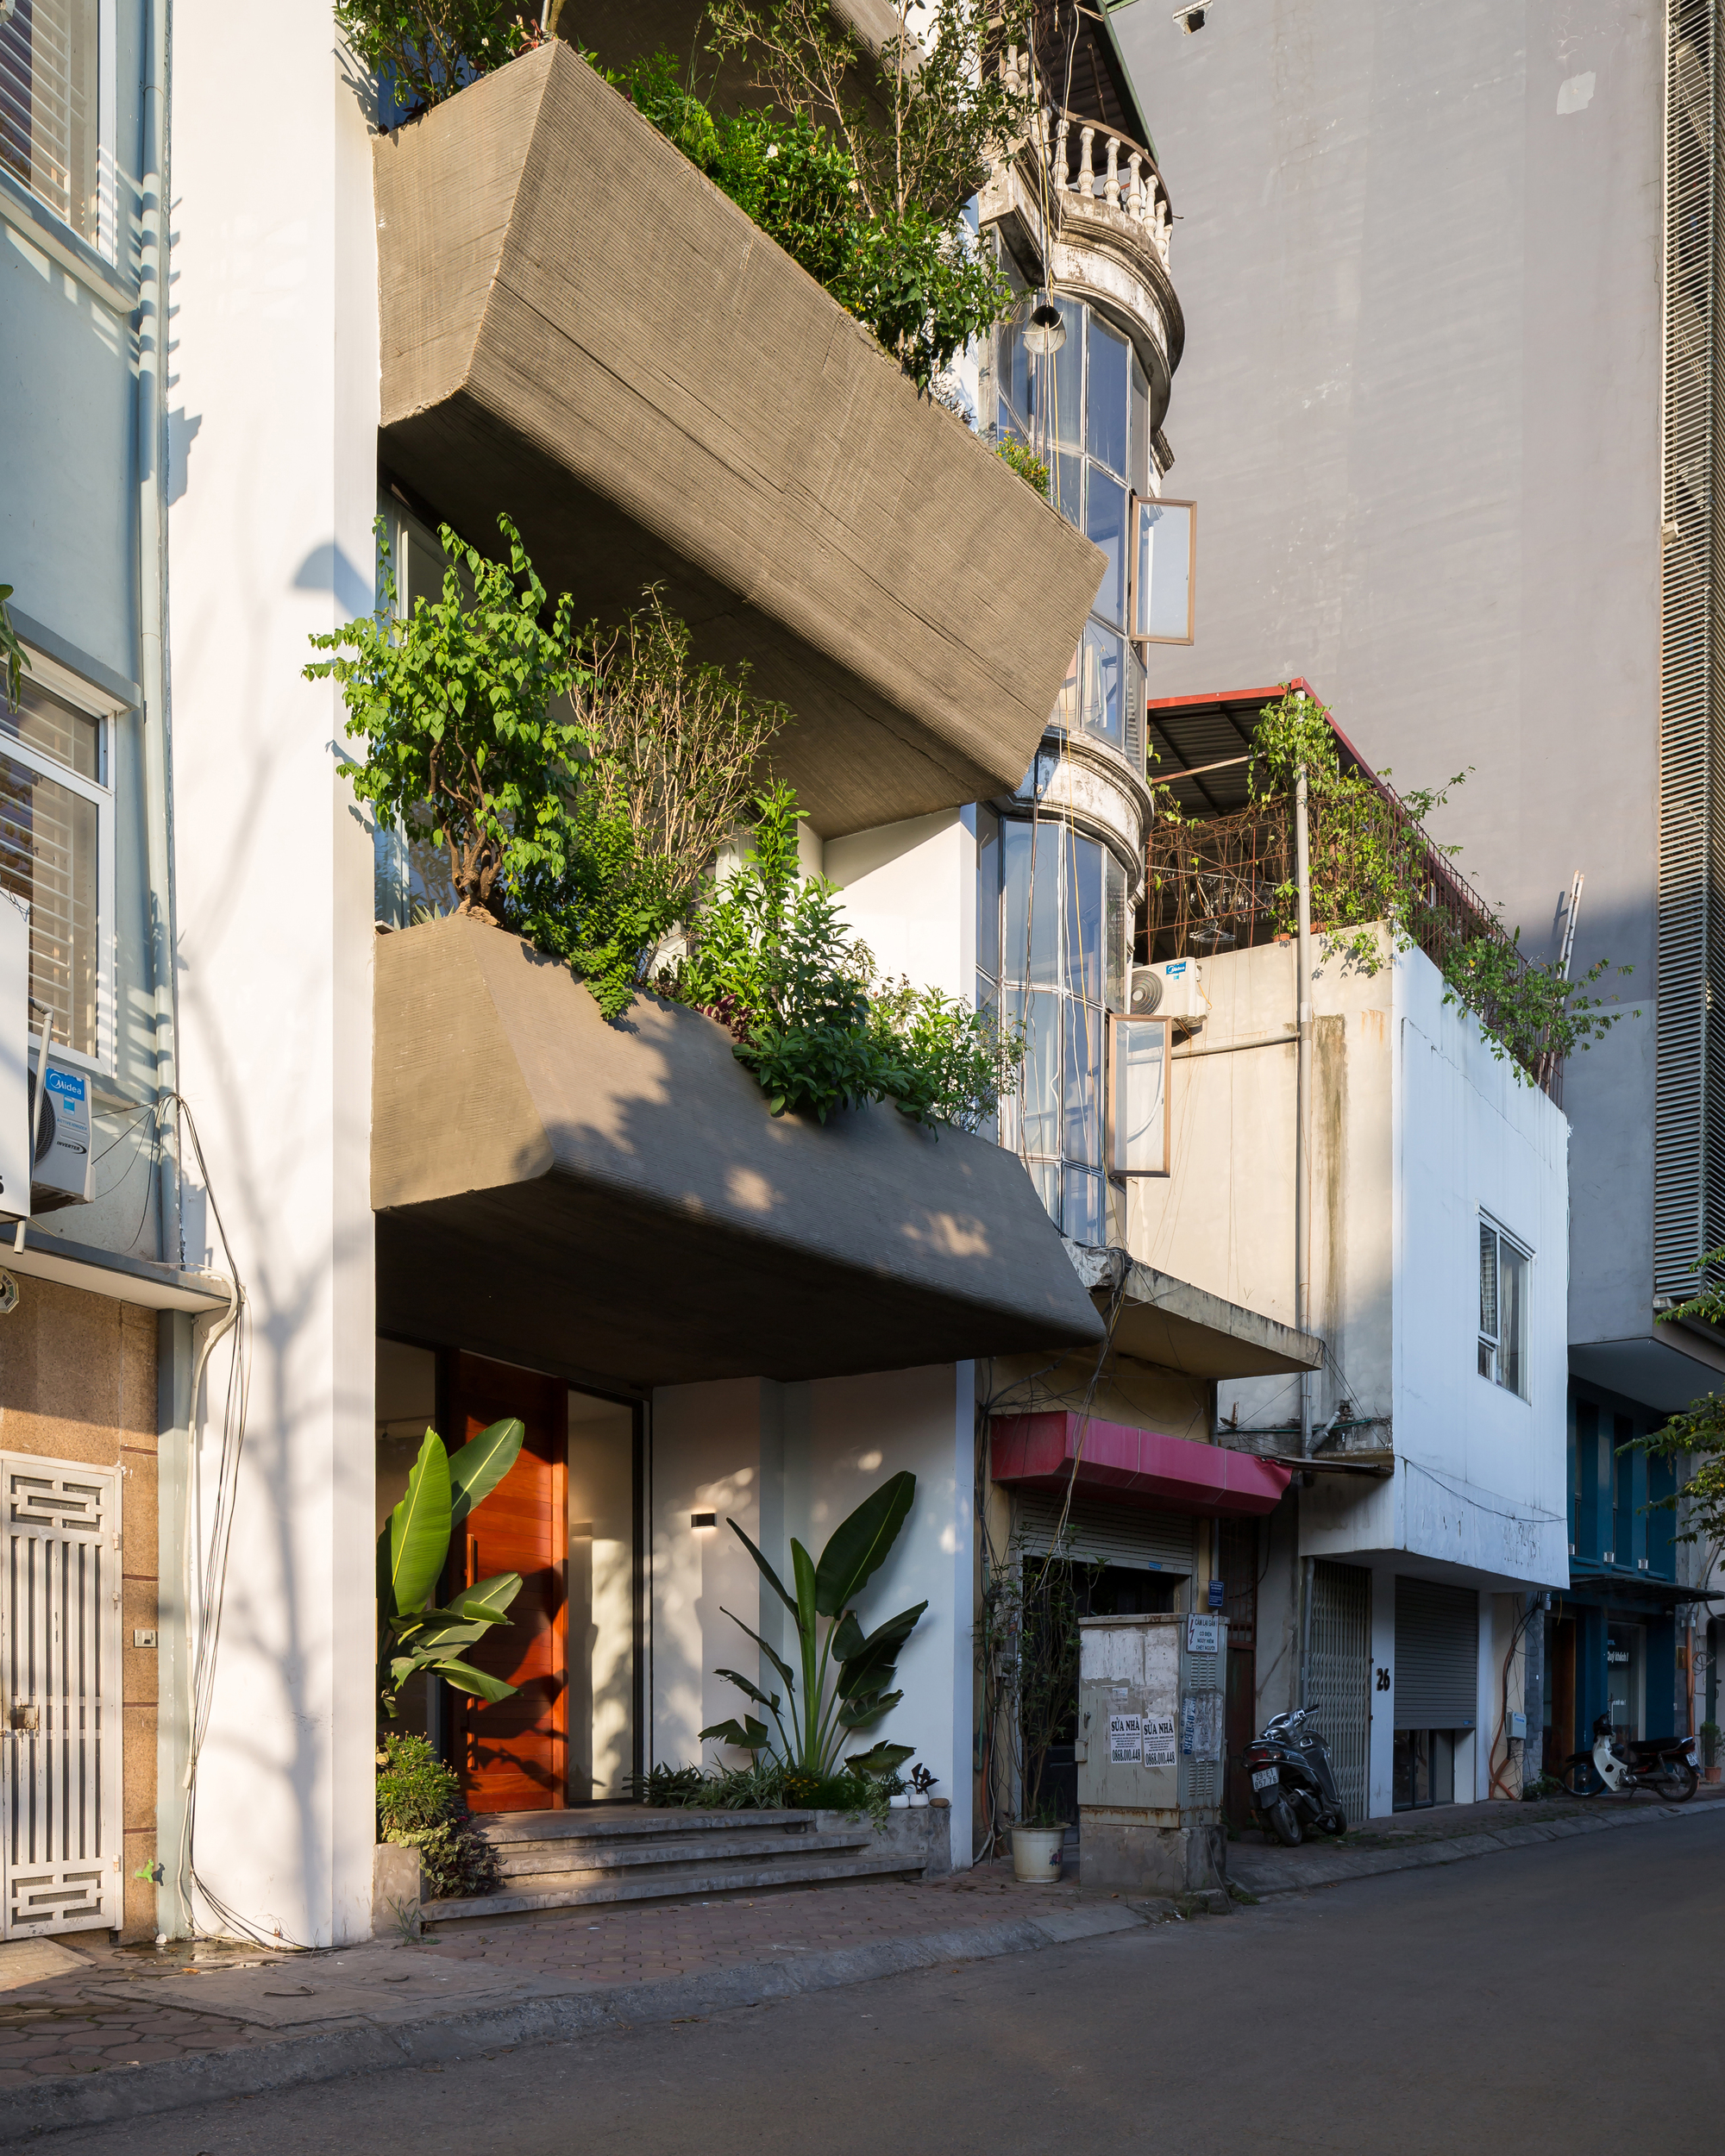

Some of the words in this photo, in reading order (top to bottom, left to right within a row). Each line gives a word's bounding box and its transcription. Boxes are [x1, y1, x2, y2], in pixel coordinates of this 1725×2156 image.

[50, 1074, 82, 1095] Midea
[56, 1141, 81, 1151] INVERTER
[1376, 1667, 1390, 1691] 26
[1111, 1717, 1124, 1731] SỬA
[1126, 1717, 1140, 1731] NHÀ
[1144, 1720, 1157, 1735] SỬA
[1158, 1719, 1173, 1734] NHÀ
[1112, 1749, 1140, 1762] 0868.010.448
[1146, 1752, 1175, 1765] 0868.010.448
[1255, 1769, 1273, 1780] 29-E1
[1255, 1776, 1277, 1788] 857.76
